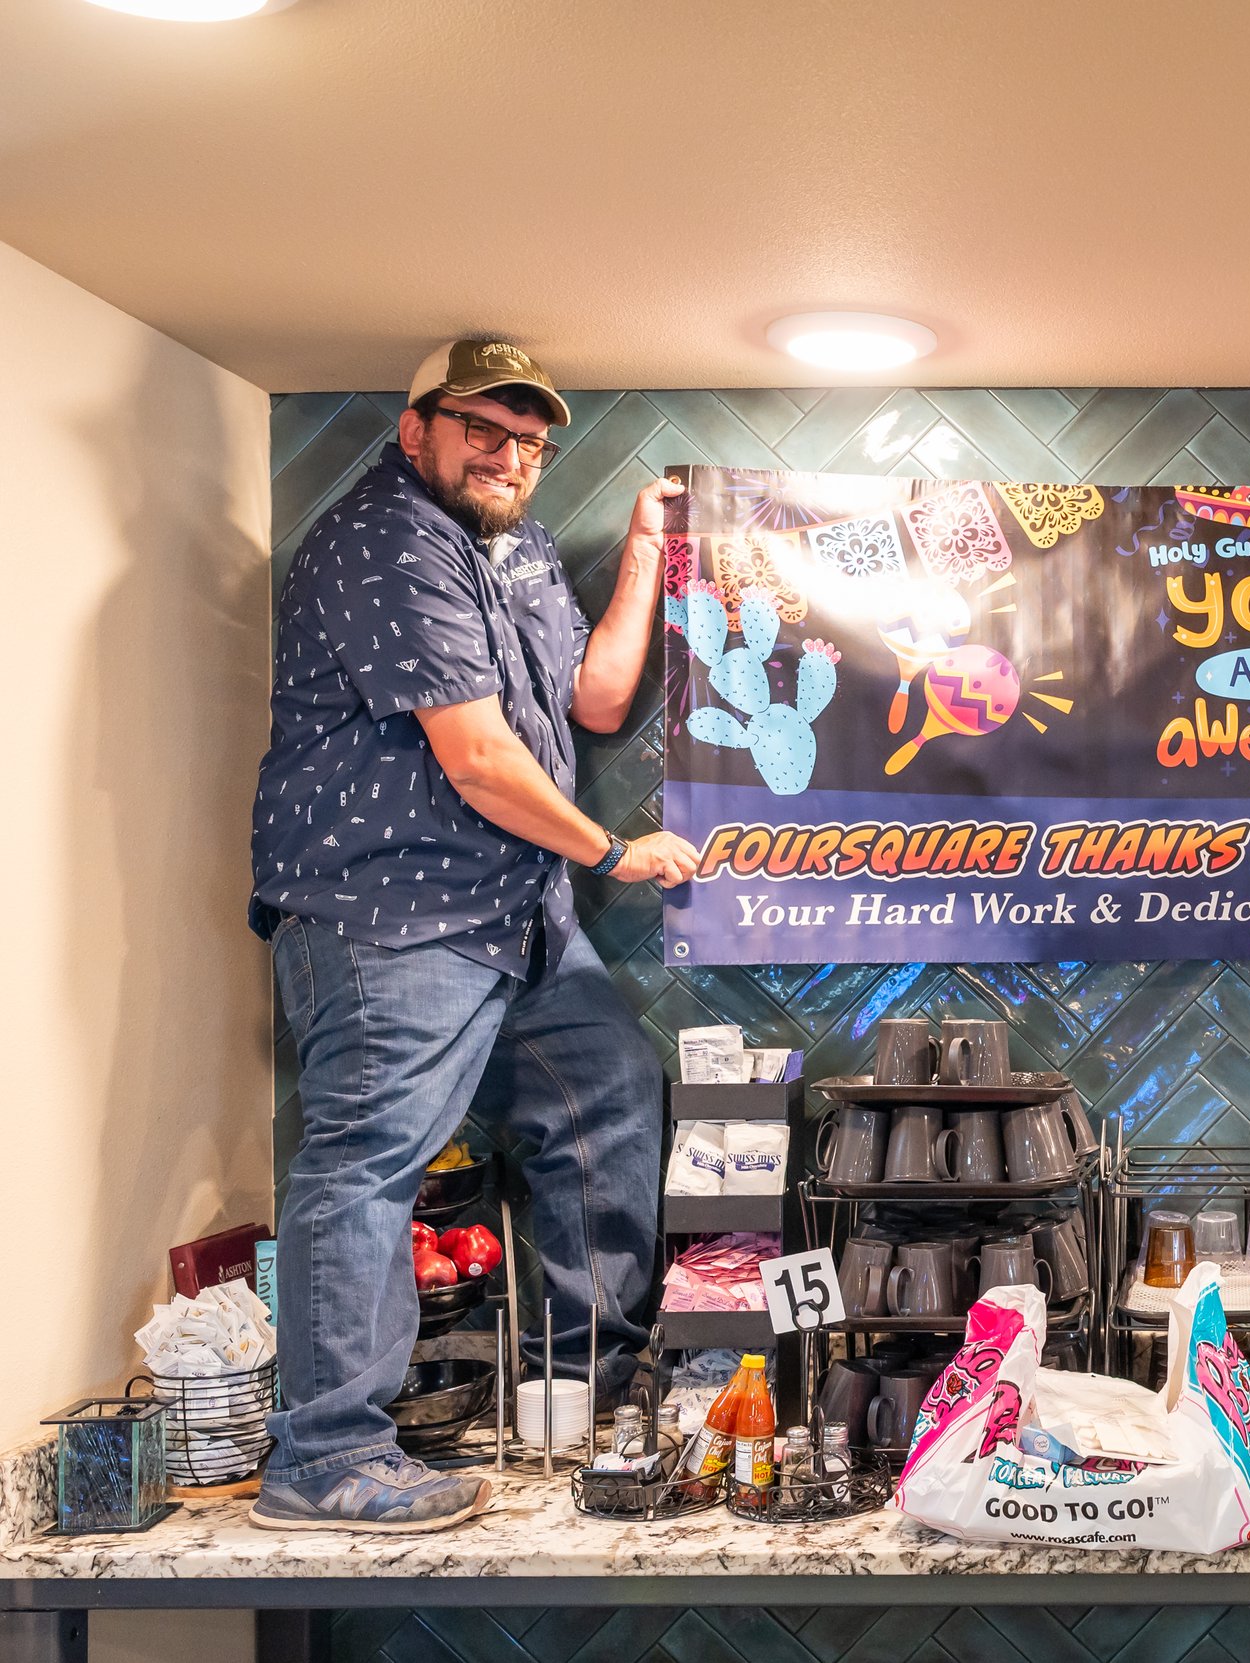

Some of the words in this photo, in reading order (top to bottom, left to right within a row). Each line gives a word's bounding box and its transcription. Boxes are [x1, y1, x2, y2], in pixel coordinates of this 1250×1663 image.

[1149, 541, 1207, 567] Holy
[697, 822, 1035, 880] FOURSQUARE
[736, 894, 834, 927] Your
[845, 892, 957, 926] Hard
[972, 892, 1076, 925] Work
[1090, 893, 1121, 925] &
[225, 1261, 253, 1279] ASHTON
[774, 1262, 830, 1316] 15
[712, 1435, 732, 1447] Cajun
[754, 1440, 772, 1453] Cajun
[754, 1449, 767, 1463] Chef
[754, 1471, 769, 1480] HOT
[985, 1497, 1058, 1523] GOOD
[1064, 1501, 1099, 1521] TO
[1010, 1530, 1137, 1545] www.rosascafe.com
